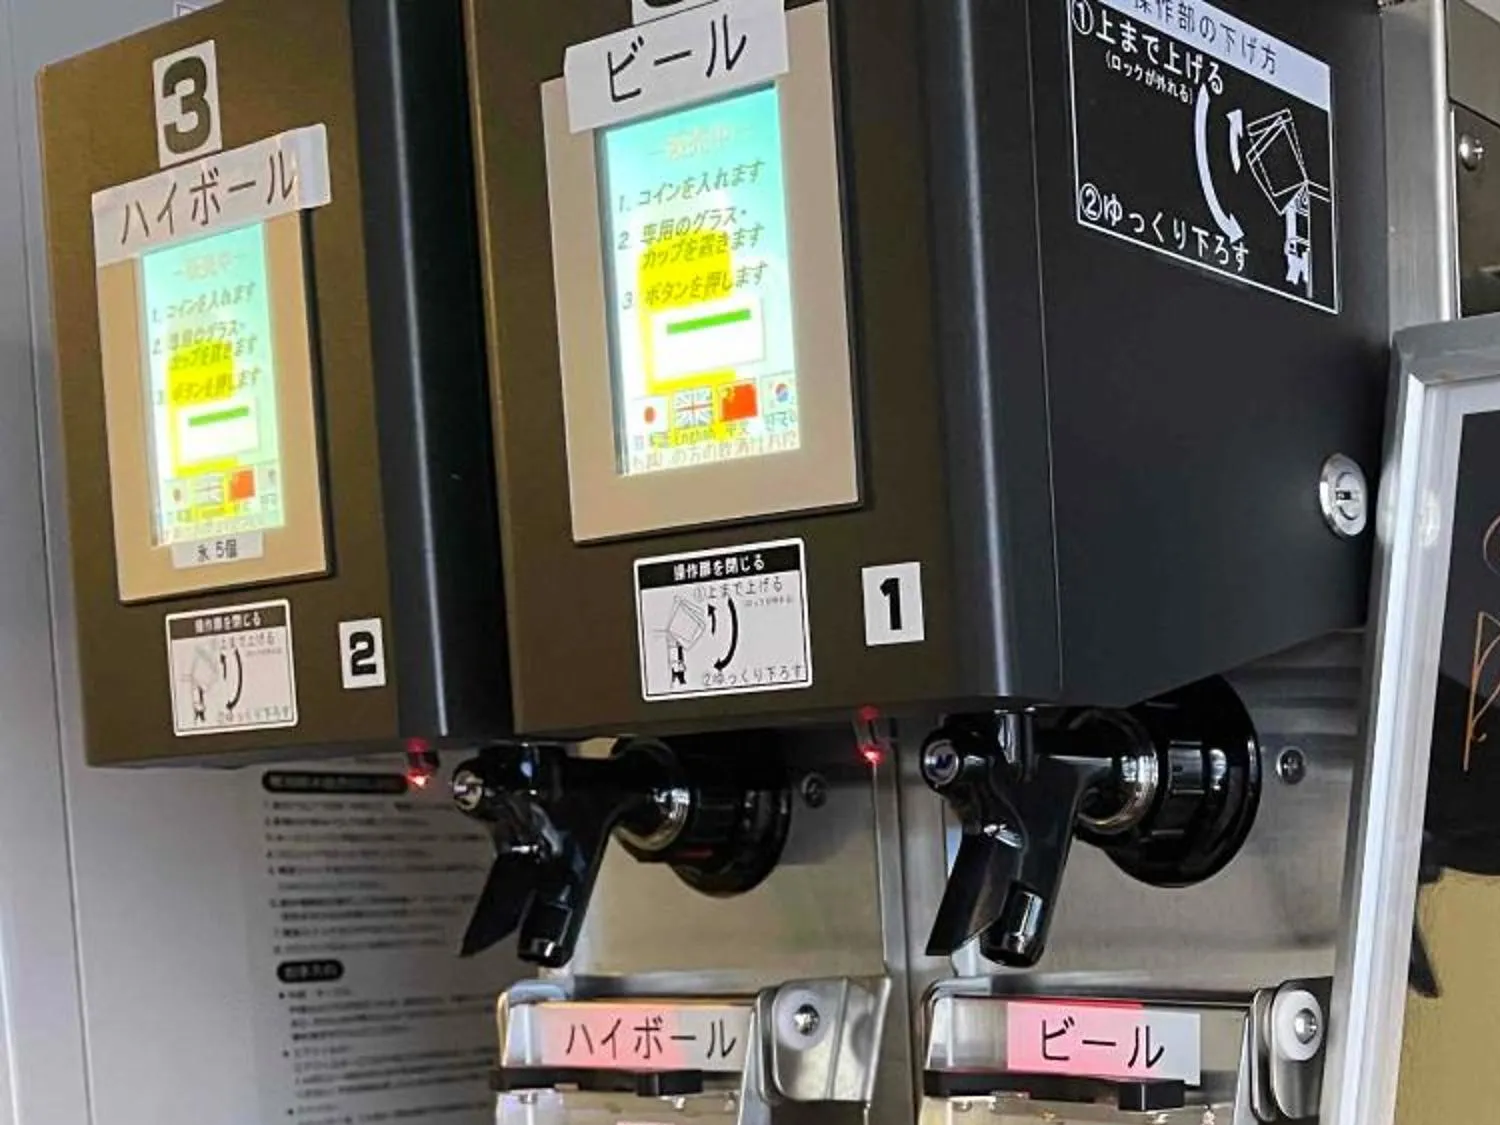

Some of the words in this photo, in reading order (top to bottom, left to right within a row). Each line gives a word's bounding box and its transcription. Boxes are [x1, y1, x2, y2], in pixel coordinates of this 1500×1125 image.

[607, 14, 747, 102] ビール
[162, 56, 211, 153] 3
[121, 151, 297, 244] ハイボール
[1079, 183, 1249, 271] ②ゆっくり下ろす
[880, 577, 902, 630] 1
[349, 631, 377, 676] 2
[565, 1016, 737, 1060] ハイボール
[1041, 1016, 1165, 1069] ビール
